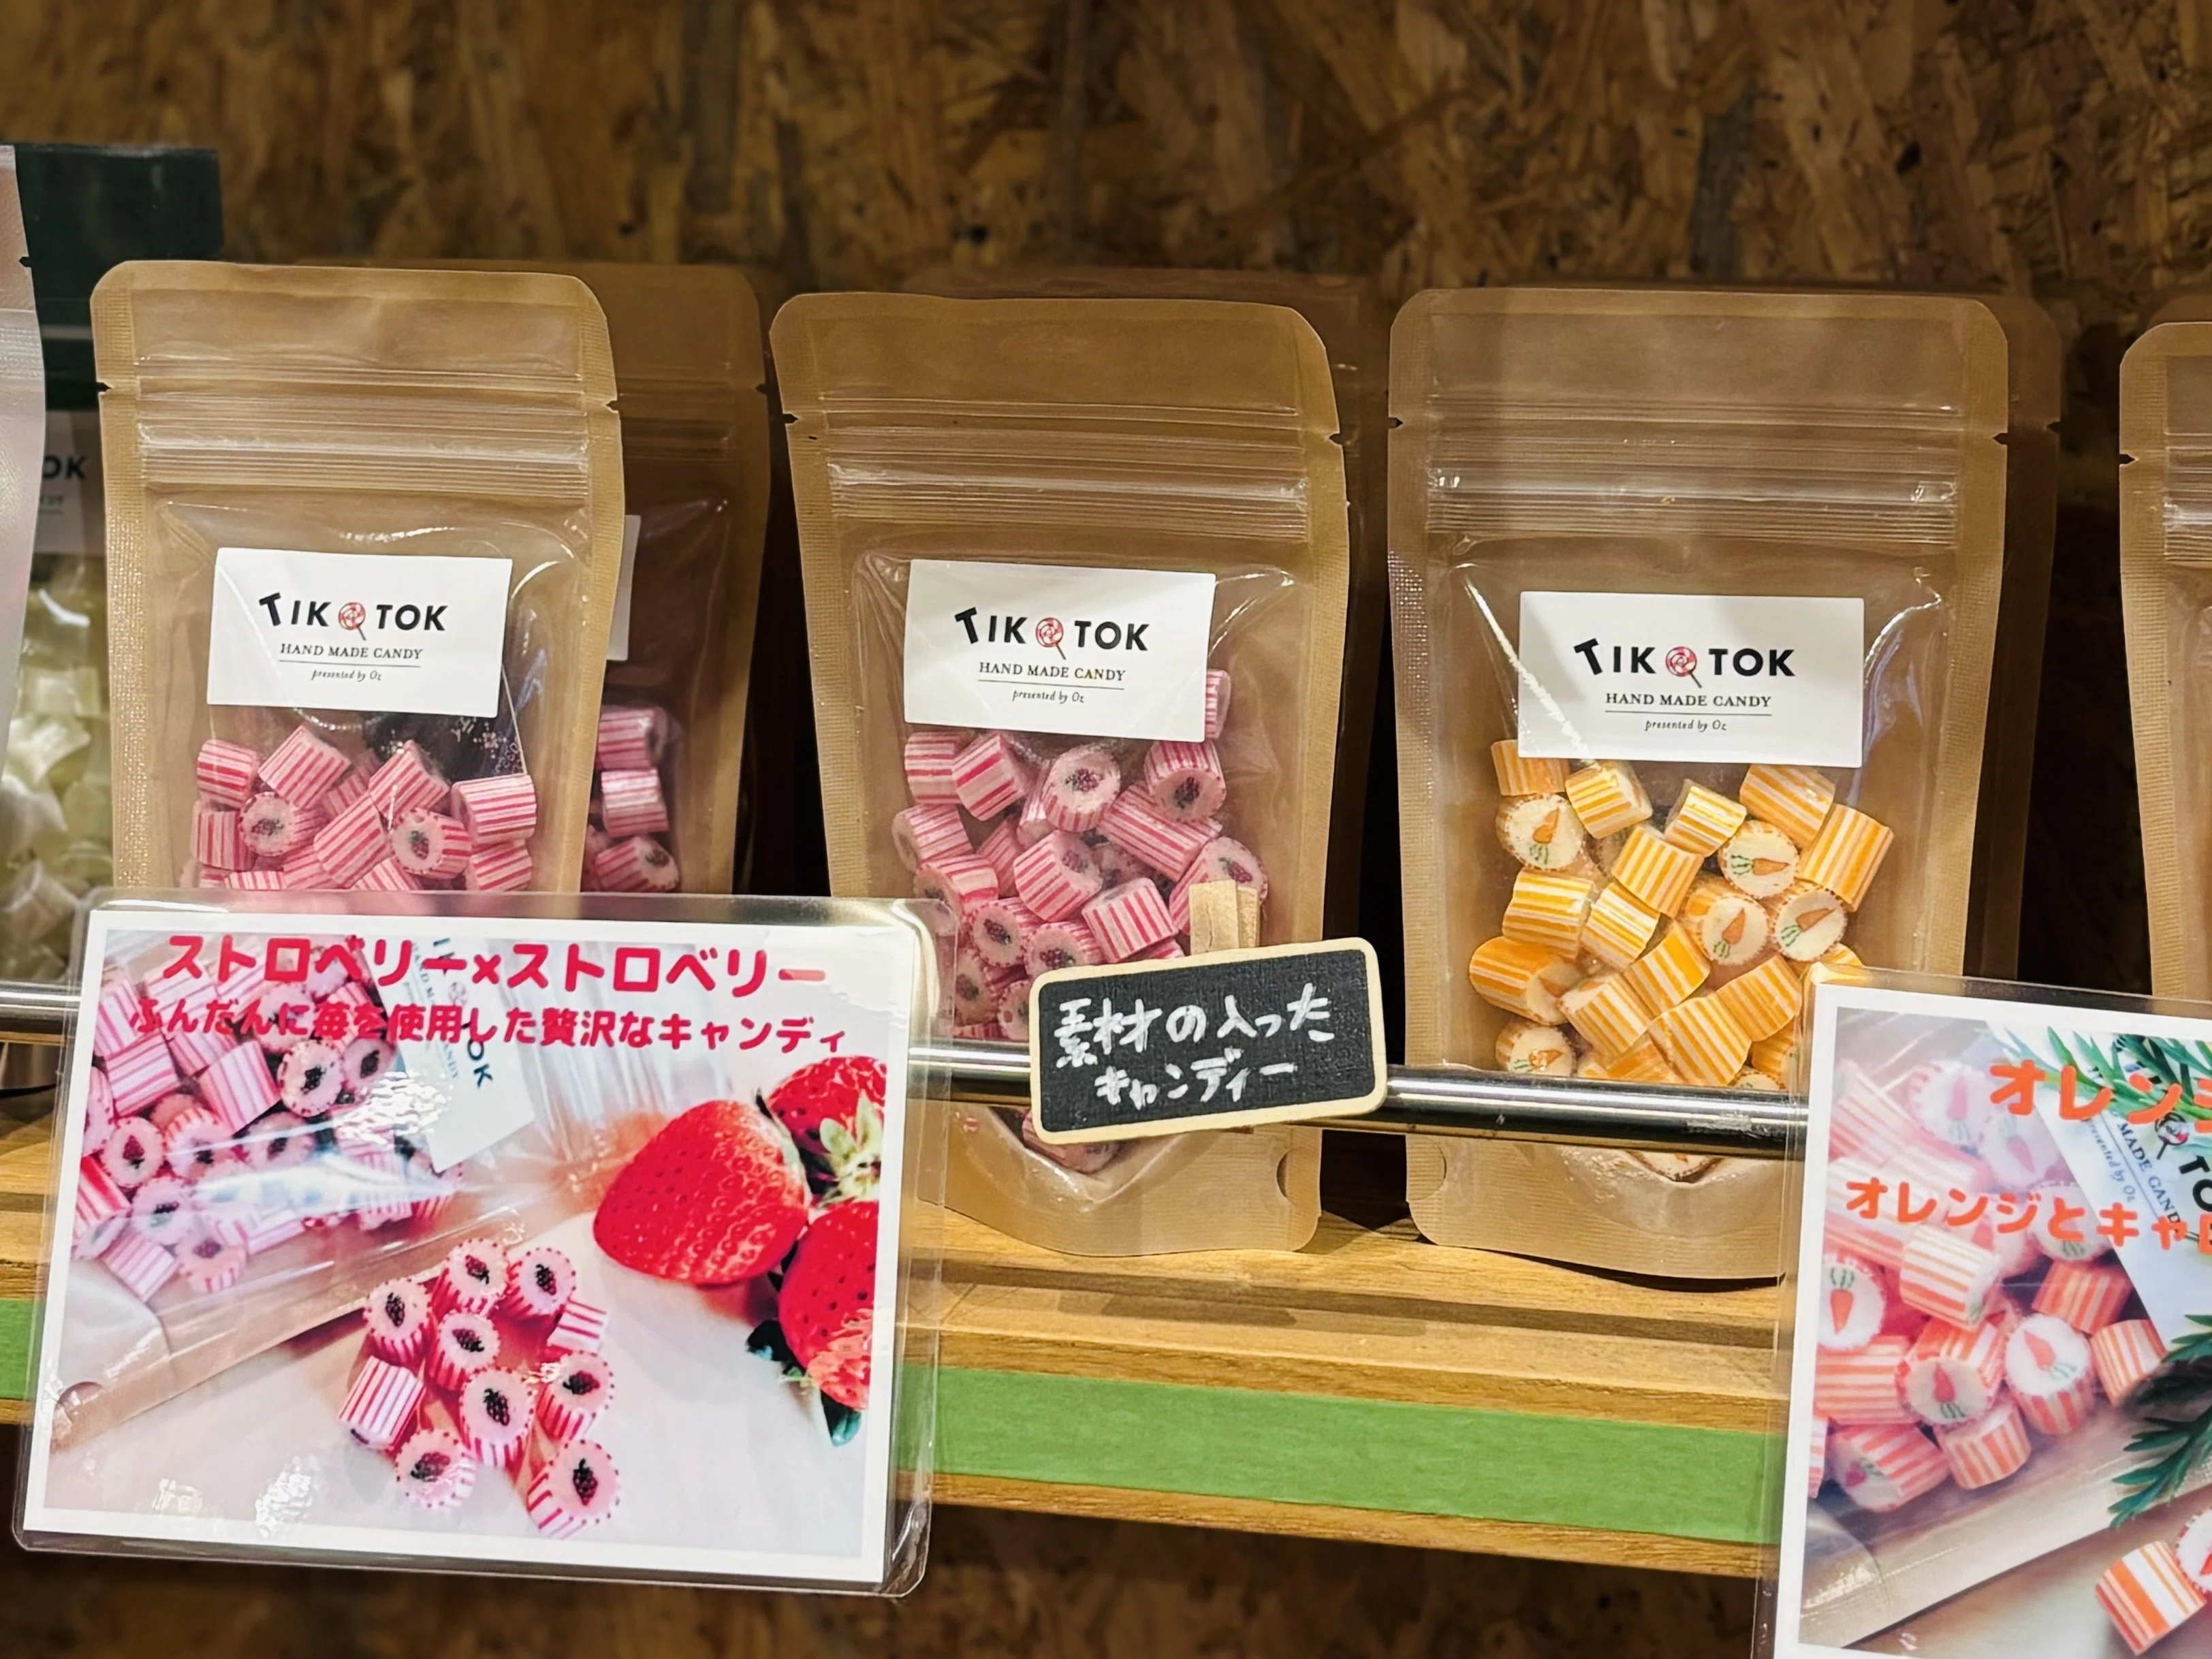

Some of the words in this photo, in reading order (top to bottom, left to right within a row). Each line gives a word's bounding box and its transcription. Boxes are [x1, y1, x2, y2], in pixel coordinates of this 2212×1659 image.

[43, 456, 87, 479] OK
[259, 592, 332, 627] TIK
[376, 604, 448, 631] TOK
[955, 607, 1027, 644] TIK
[1074, 620, 1150, 651] TOK
[280, 643, 323, 656] HAND
[328, 646, 368, 659] MADE
[373, 648, 424, 660] CANDY
[1574, 638, 1656, 675] TIK
[1709, 648, 1796, 677] TOK
[311, 669, 355, 681] presented
[358, 671, 366, 682] by
[369, 671, 382, 681] Oz
[979, 662, 1023, 676] HAND
[1028, 665, 1069, 678] MADE
[1074, 668, 1126, 681] CANDY
[1012, 690, 1056, 701] presented
[1059, 691, 1068, 704] by
[1071, 693, 1084, 704] Oz
[1605, 693, 1654, 706] HAND
[1660, 695, 1707, 707] MADE
[1713, 695, 1772, 708] CANDY
[1645, 719, 1694, 731] presented
[1697, 720, 1708, 733] by
[1711, 720, 1728, 731] Oz
[1054, 982, 1335, 1068] 素材の入った
[1094, 1047, 1297, 1110] キャンディー
[2149, 1176, 2183, 1227] CAND
